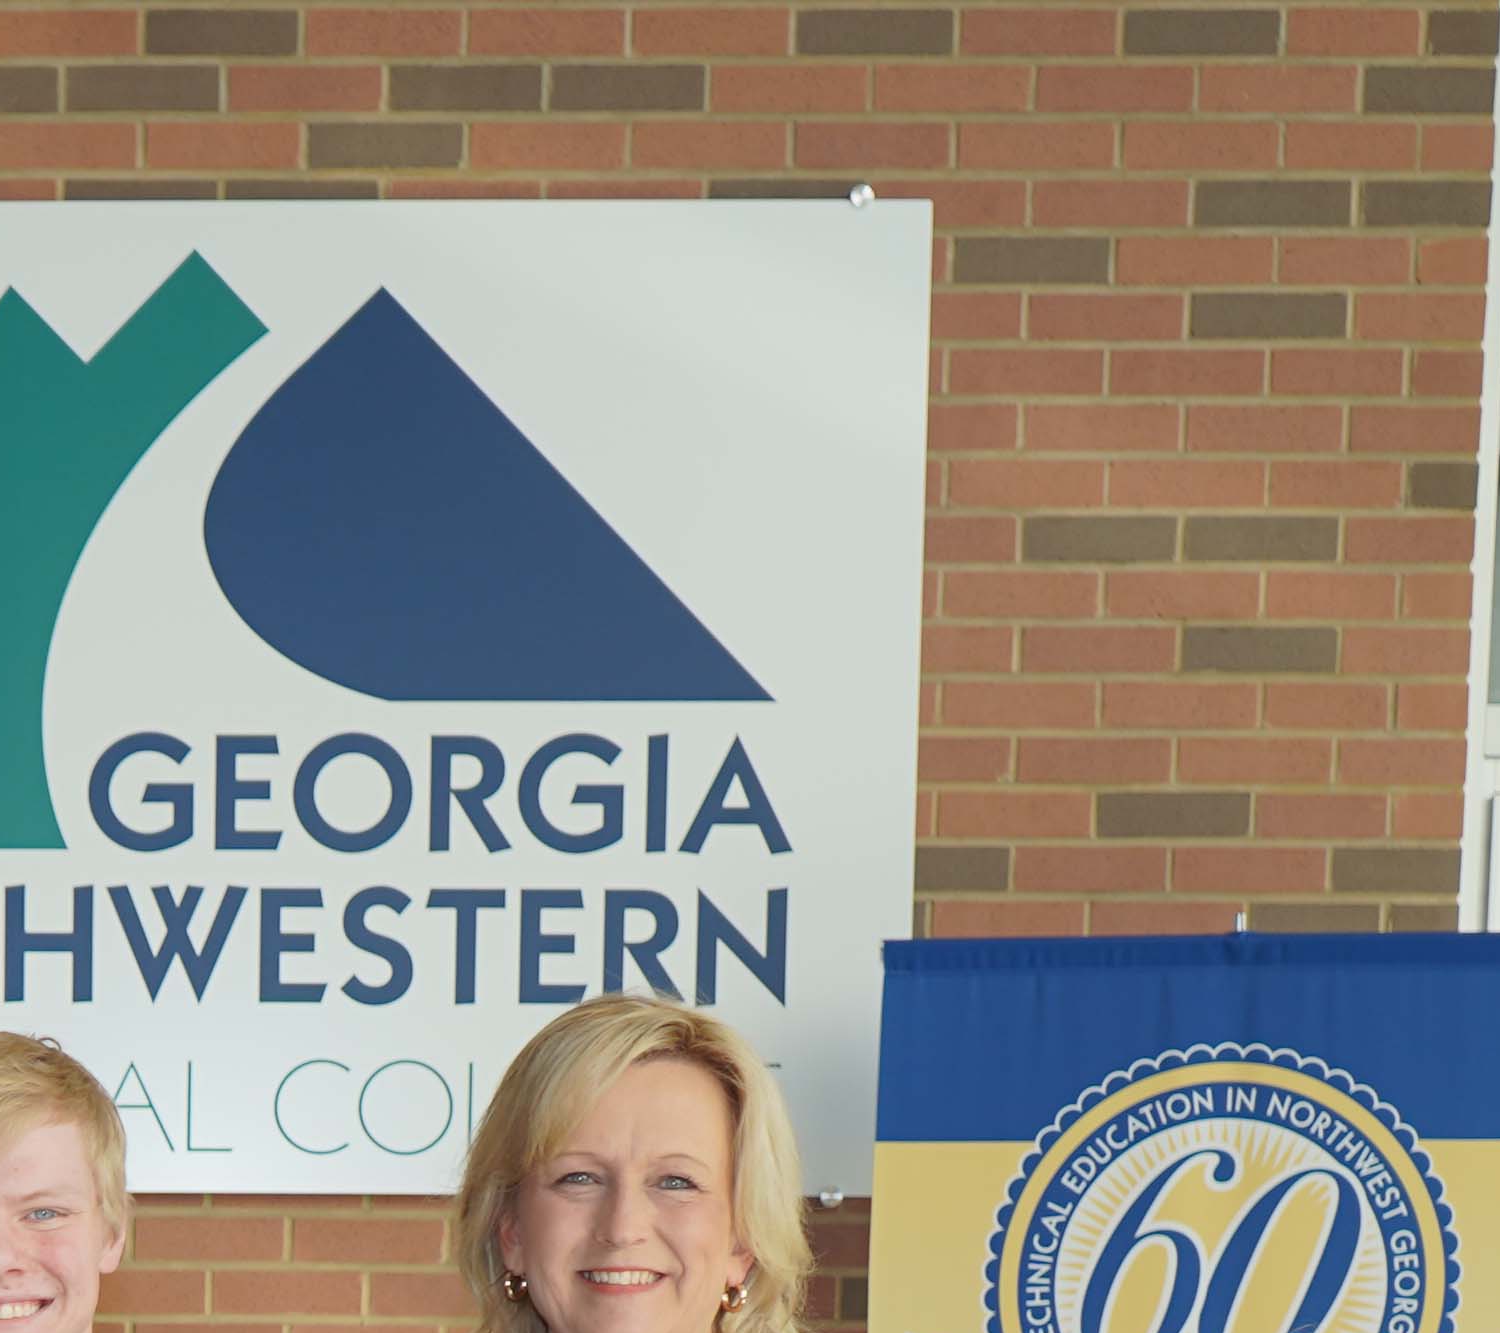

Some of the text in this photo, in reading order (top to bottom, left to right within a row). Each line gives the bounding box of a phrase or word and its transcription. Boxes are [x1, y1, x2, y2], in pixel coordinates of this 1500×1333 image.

[88, 730, 794, 855] GEORGIA
[1060, 1086, 1215, 1196] EDUCATION
[1225, 1087, 1257, 1113] IN
[1265, 1088, 1410, 1221] NORTHWEST
